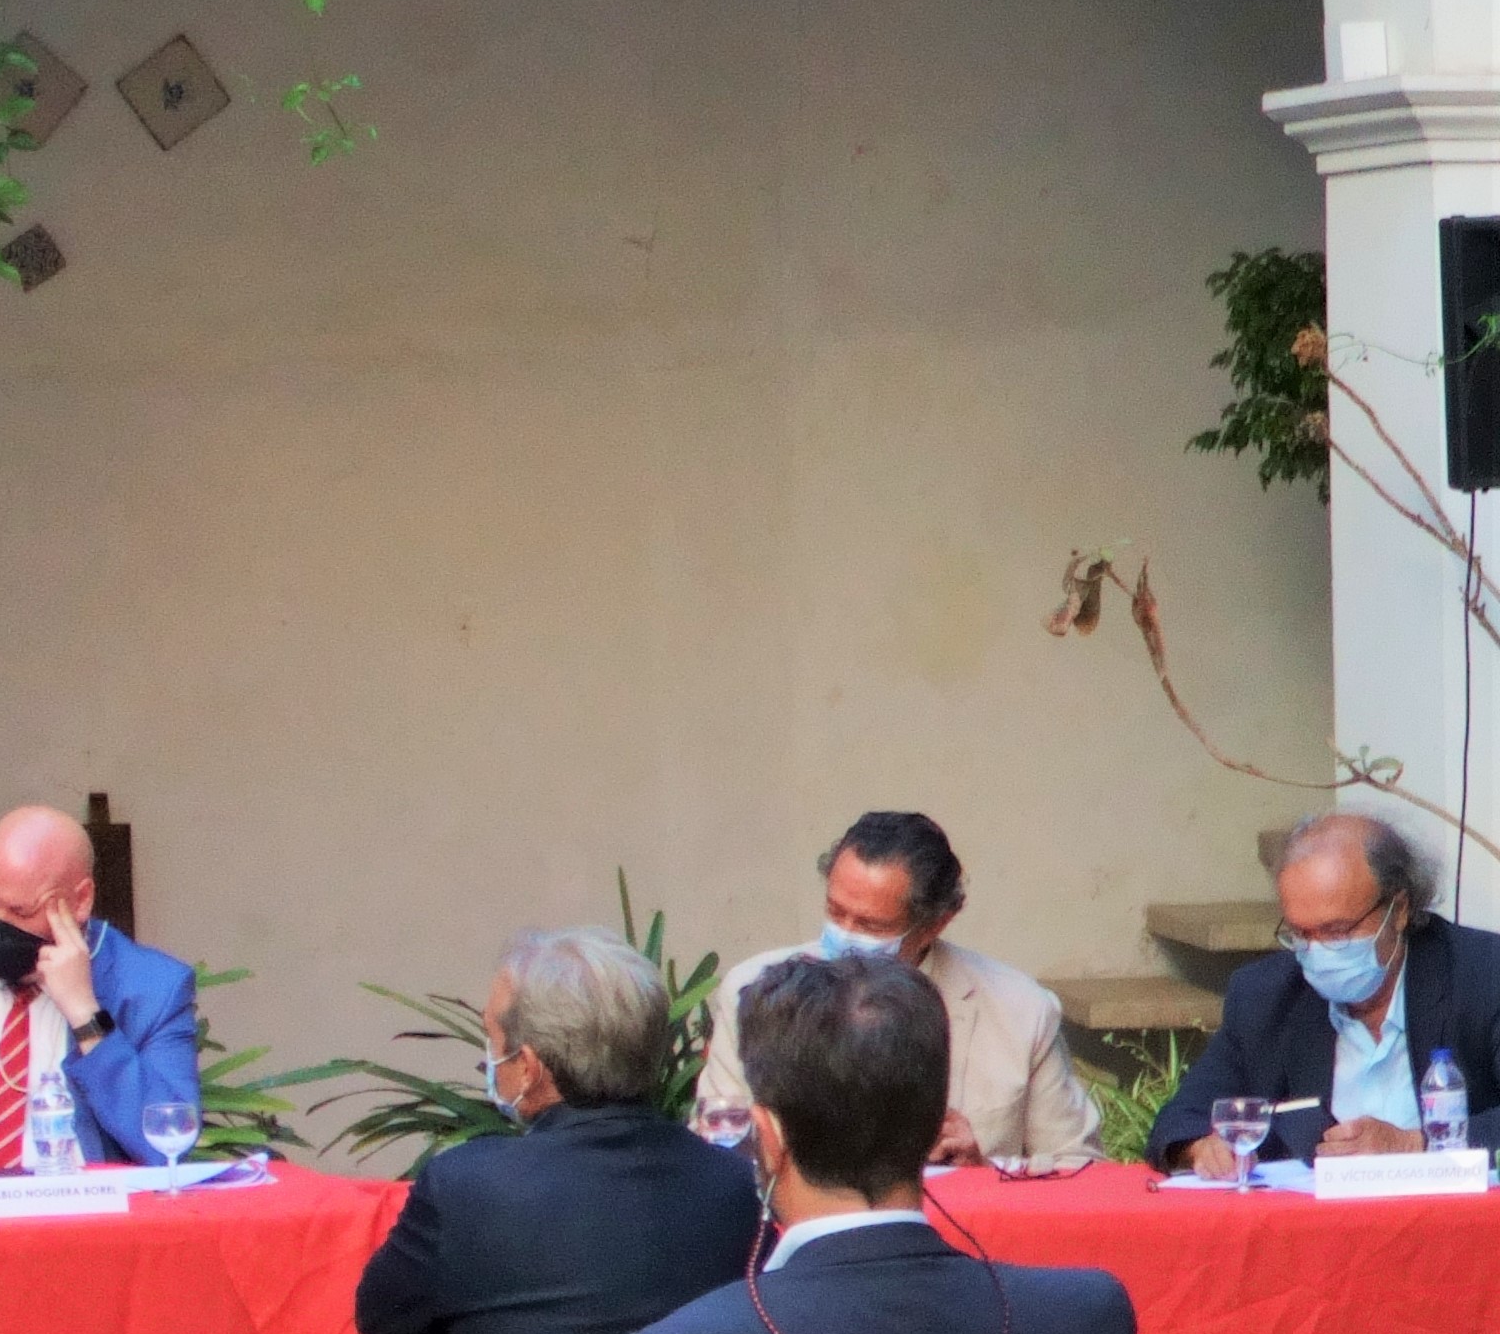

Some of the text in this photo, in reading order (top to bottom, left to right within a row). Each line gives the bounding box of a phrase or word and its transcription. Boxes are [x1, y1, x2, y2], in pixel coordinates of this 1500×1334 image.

[1388, 1167, 1425, 1181] CASAS
[26, 1187, 81, 1199] NOGUERA
[84, 1185, 117, 1196] BOREL
